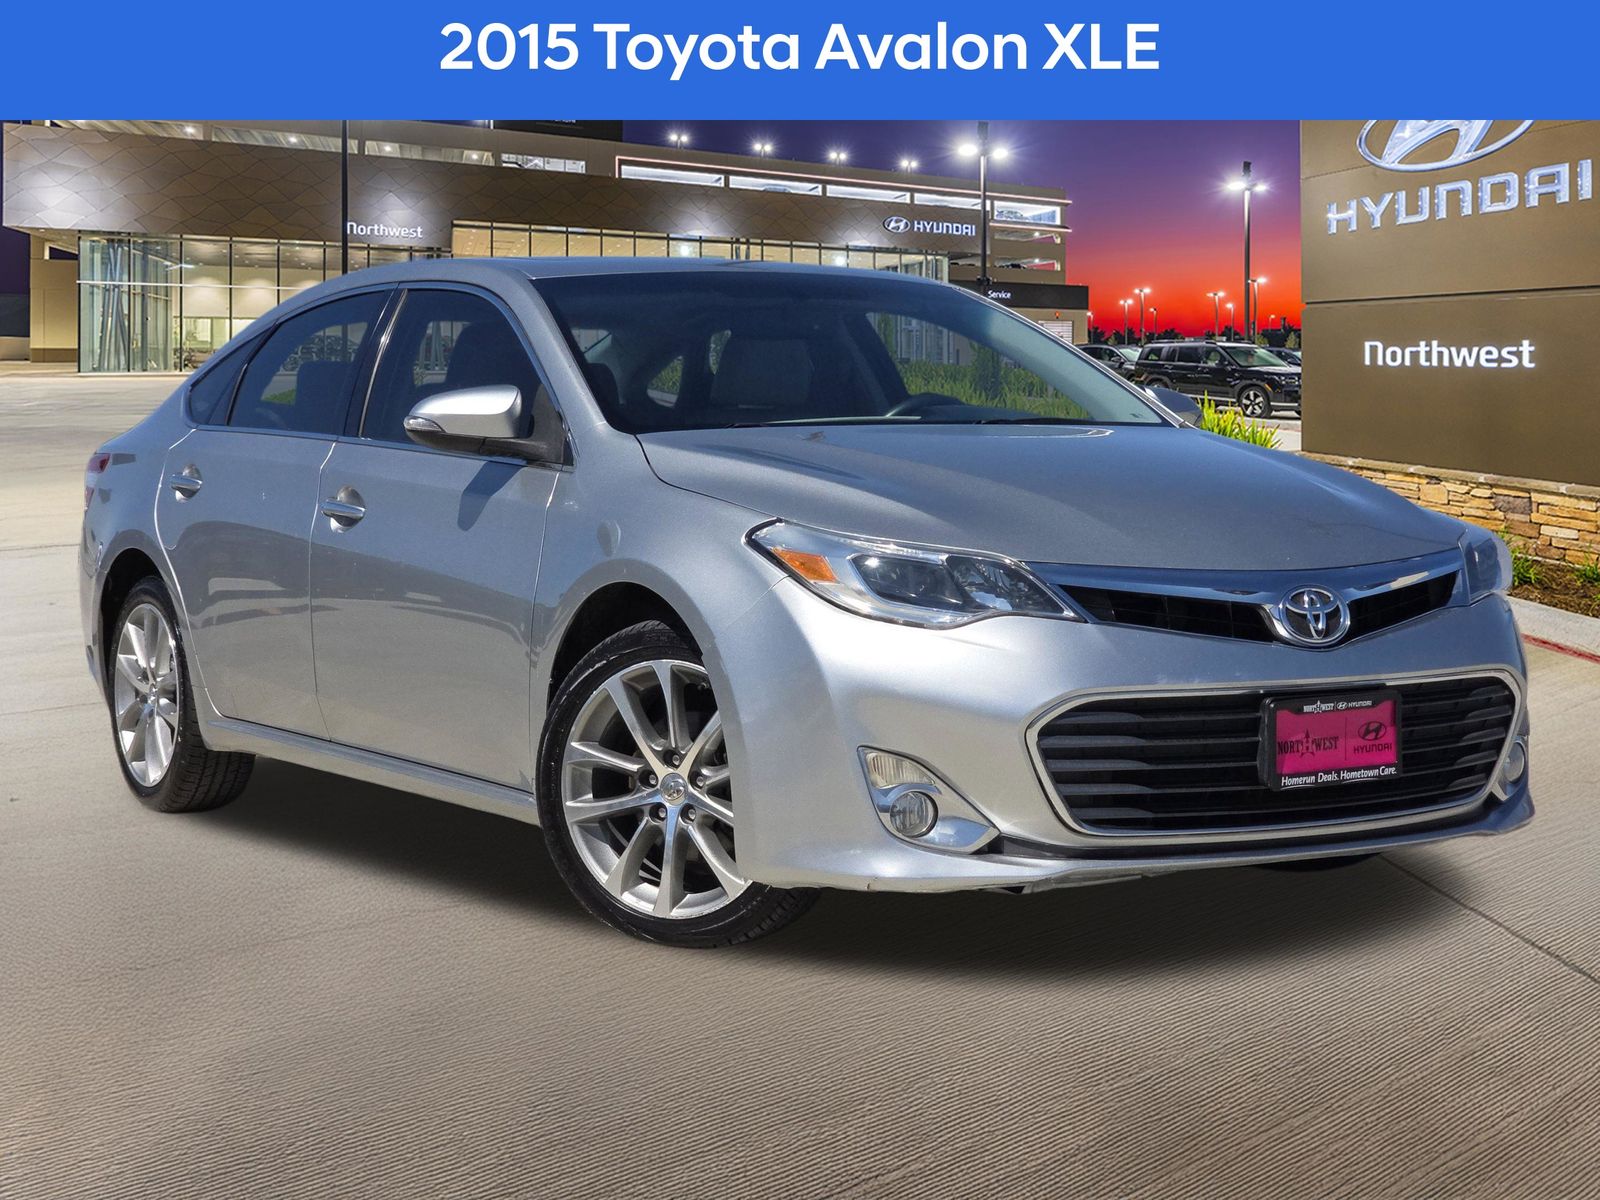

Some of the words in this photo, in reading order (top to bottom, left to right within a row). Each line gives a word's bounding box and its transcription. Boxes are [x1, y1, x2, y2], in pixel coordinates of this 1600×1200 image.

[1326, 159, 1593, 235] HYUNDAI
[346, 221, 423, 238] Northwest
[913, 220, 976, 236] HYUNDAI
[987, 289, 1012, 300] Service
[1363, 339, 1536, 369] Northwest
[1353, 742, 1392, 755] HYUNDAI
[1281, 775, 1316, 787] Homerun
[1317, 772, 1339, 782] Deals.
[1340, 768, 1379, 780] Hometown
[1379, 765, 1397, 776] Care.
